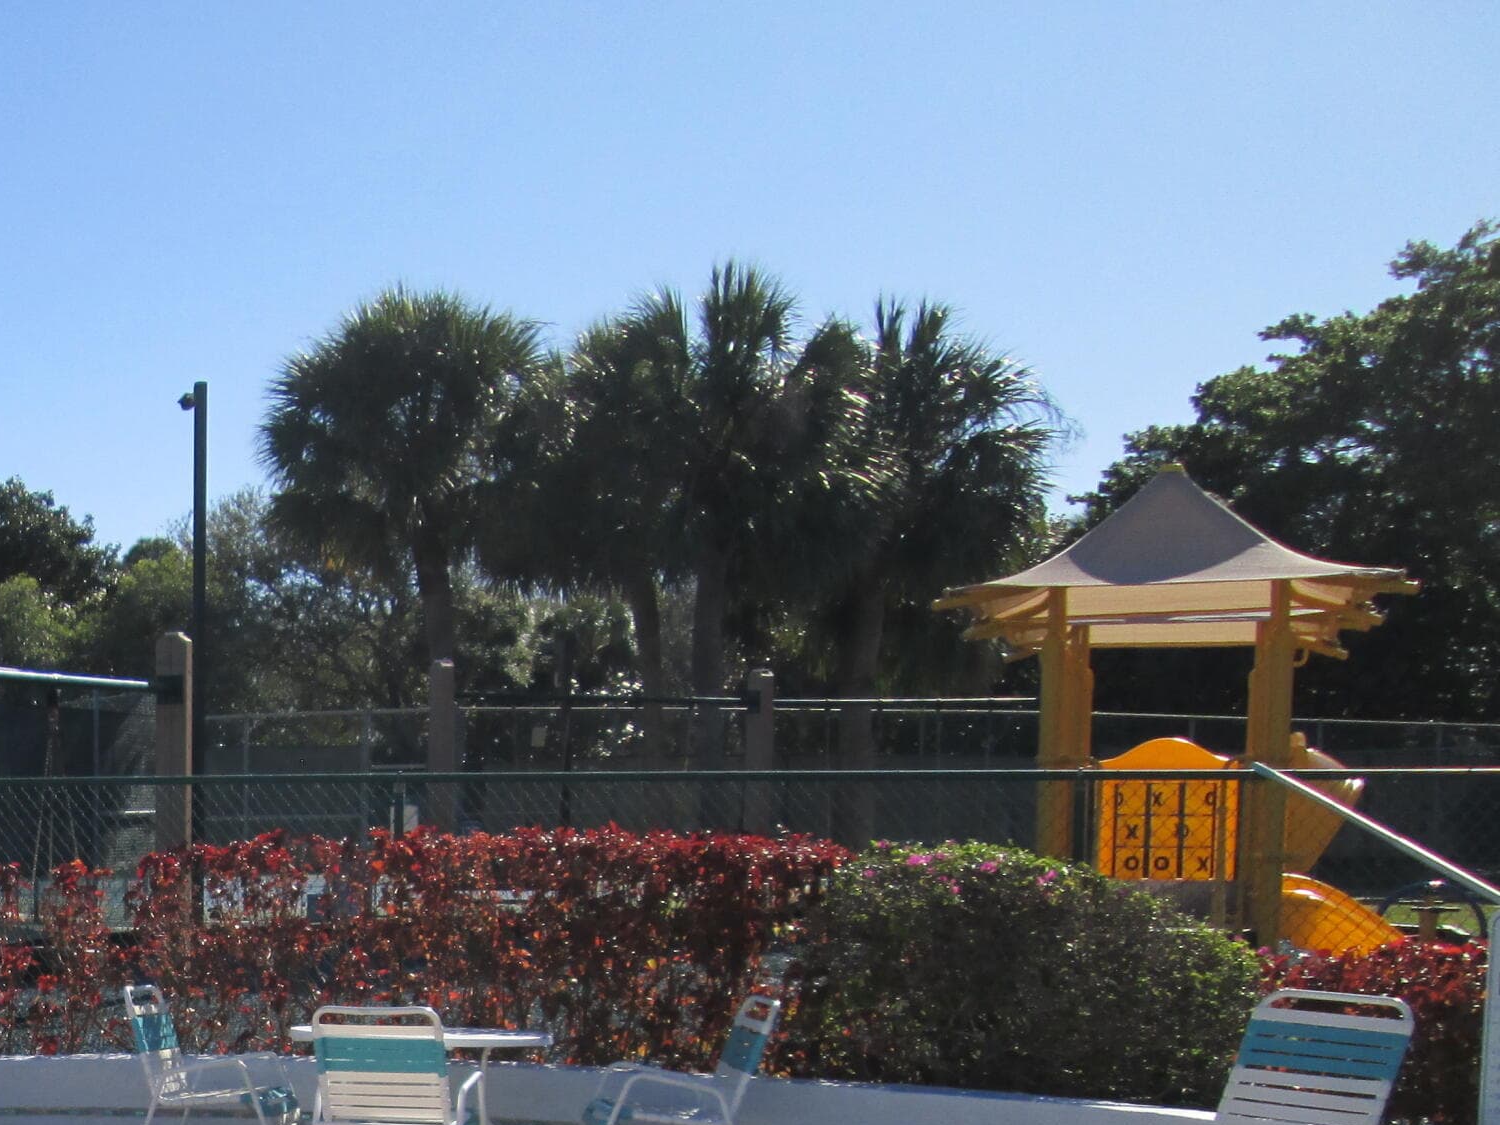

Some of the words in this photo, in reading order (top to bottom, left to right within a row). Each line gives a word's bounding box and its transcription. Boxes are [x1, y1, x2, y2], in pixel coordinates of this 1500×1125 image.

[1125, 824, 1139, 839] X
[1124, 856, 1139, 871] O
[1154, 856, 1170, 871] O
[1197, 856, 1210, 871] X
